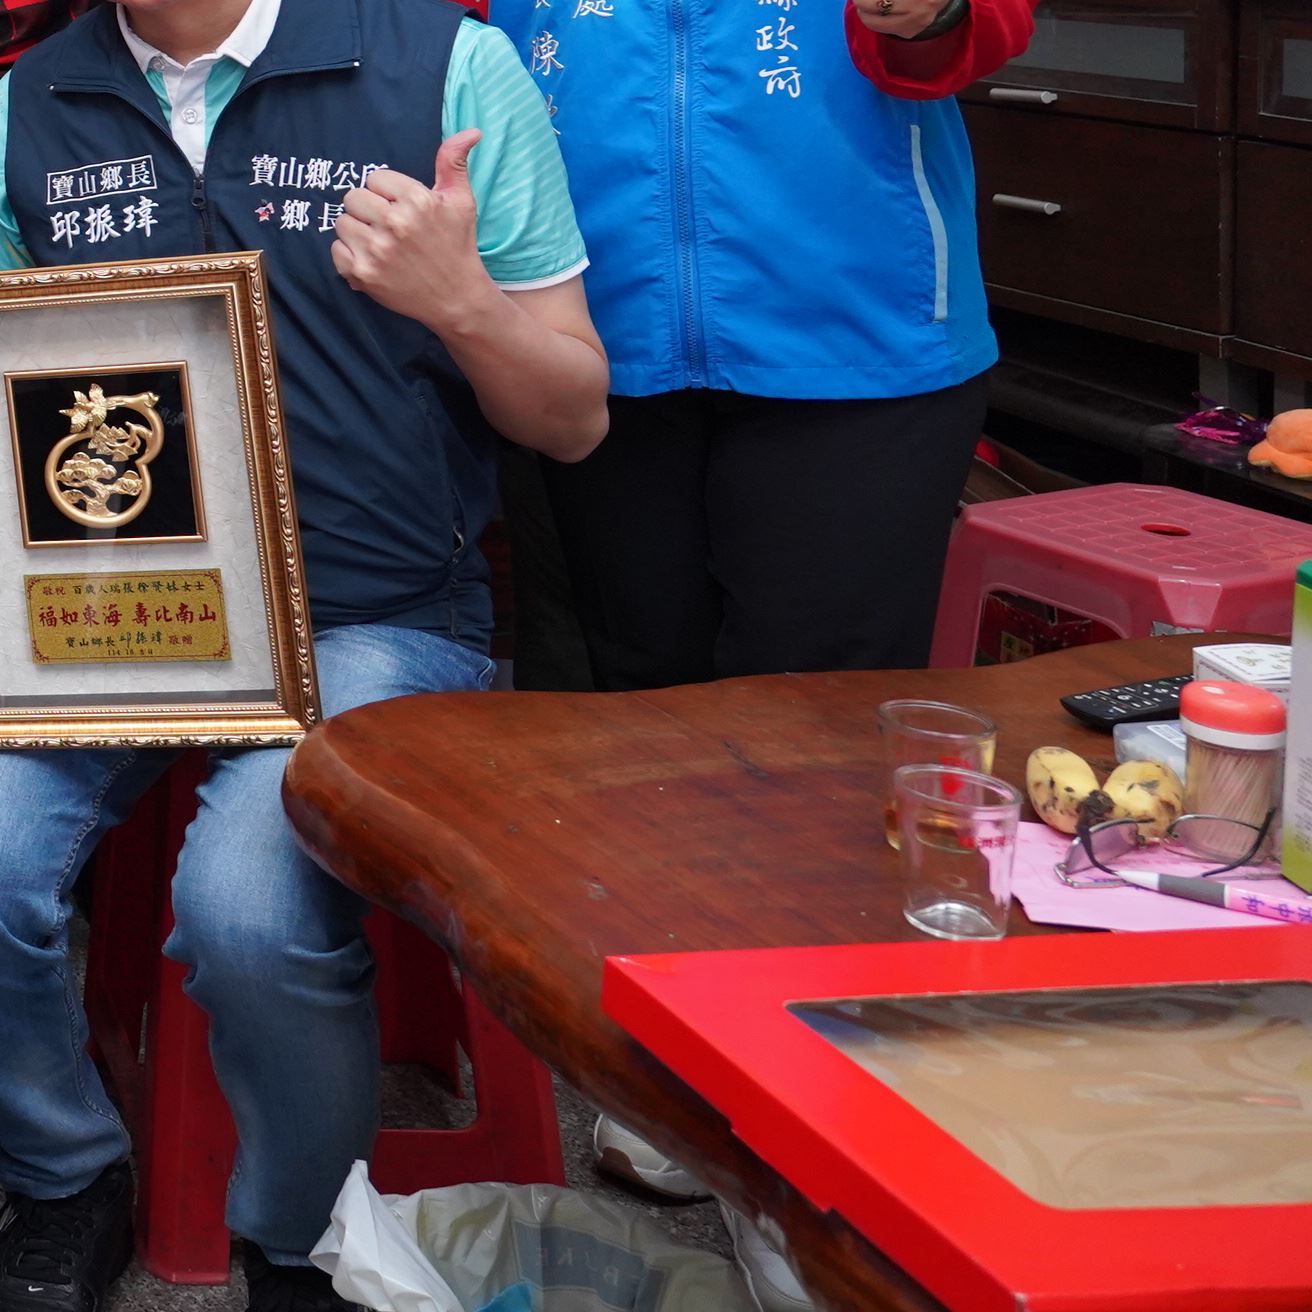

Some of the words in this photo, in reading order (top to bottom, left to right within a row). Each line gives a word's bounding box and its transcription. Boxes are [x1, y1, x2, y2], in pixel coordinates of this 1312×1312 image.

[52, 160, 152, 200] 寶山鄉長
[50, 196, 160, 249] 邱振瑋
[281, 200, 345, 233] 鄉長
[39, 603, 123, 628] 福如東海
[132, 602, 216, 627] 壽比南山
